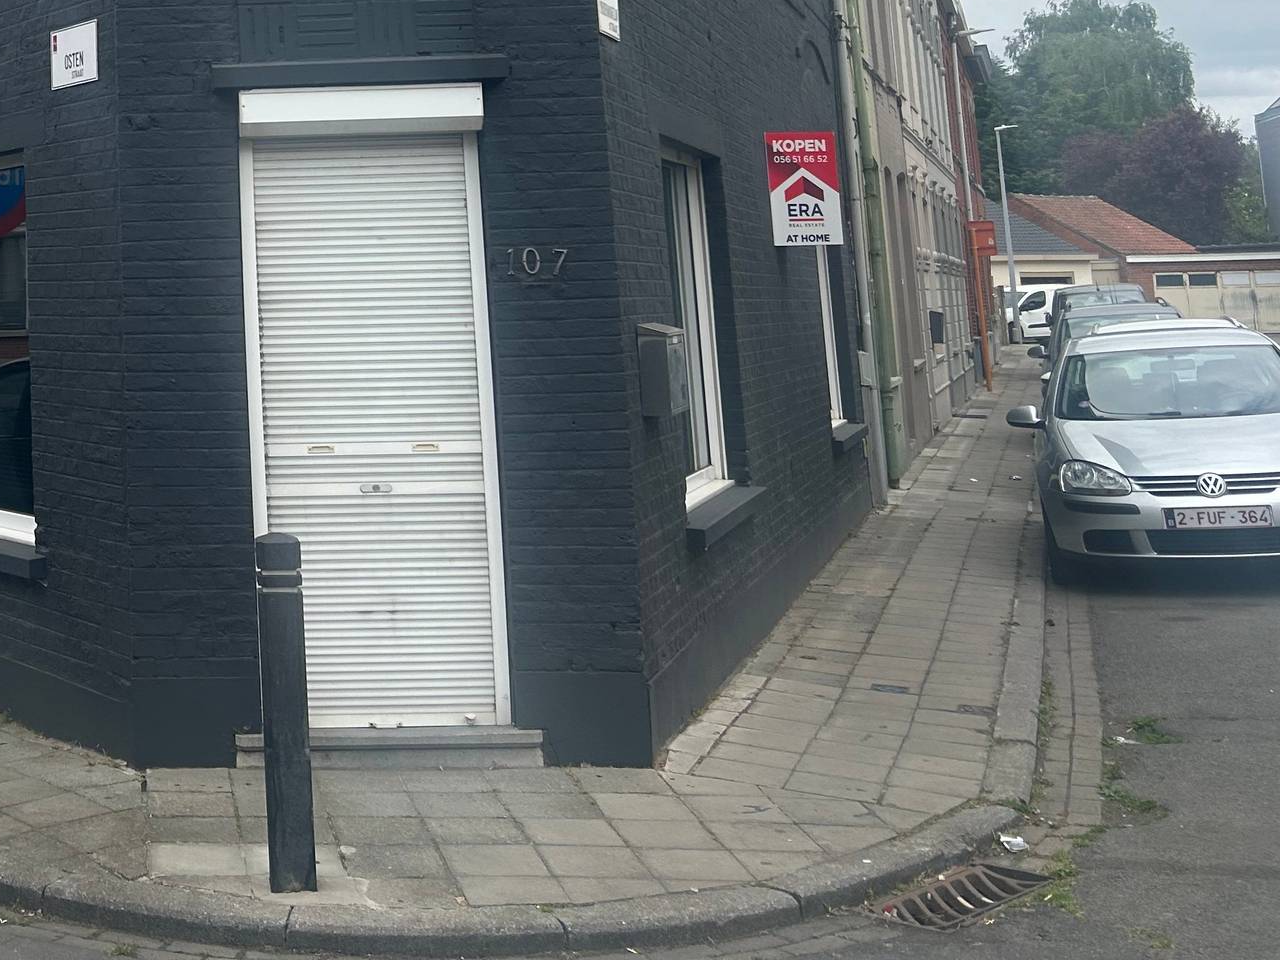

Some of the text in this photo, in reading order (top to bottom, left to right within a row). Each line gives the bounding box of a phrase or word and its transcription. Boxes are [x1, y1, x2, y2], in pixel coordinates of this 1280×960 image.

[64, 51, 84, 69] OSTEN
[772, 139, 826, 152] KOPEN
[773, 155, 828, 163] 056 51 66 52
[787, 203, 823, 217] ERA
[786, 234, 830, 242] AT HOME
[506, 247, 568, 275] 107
